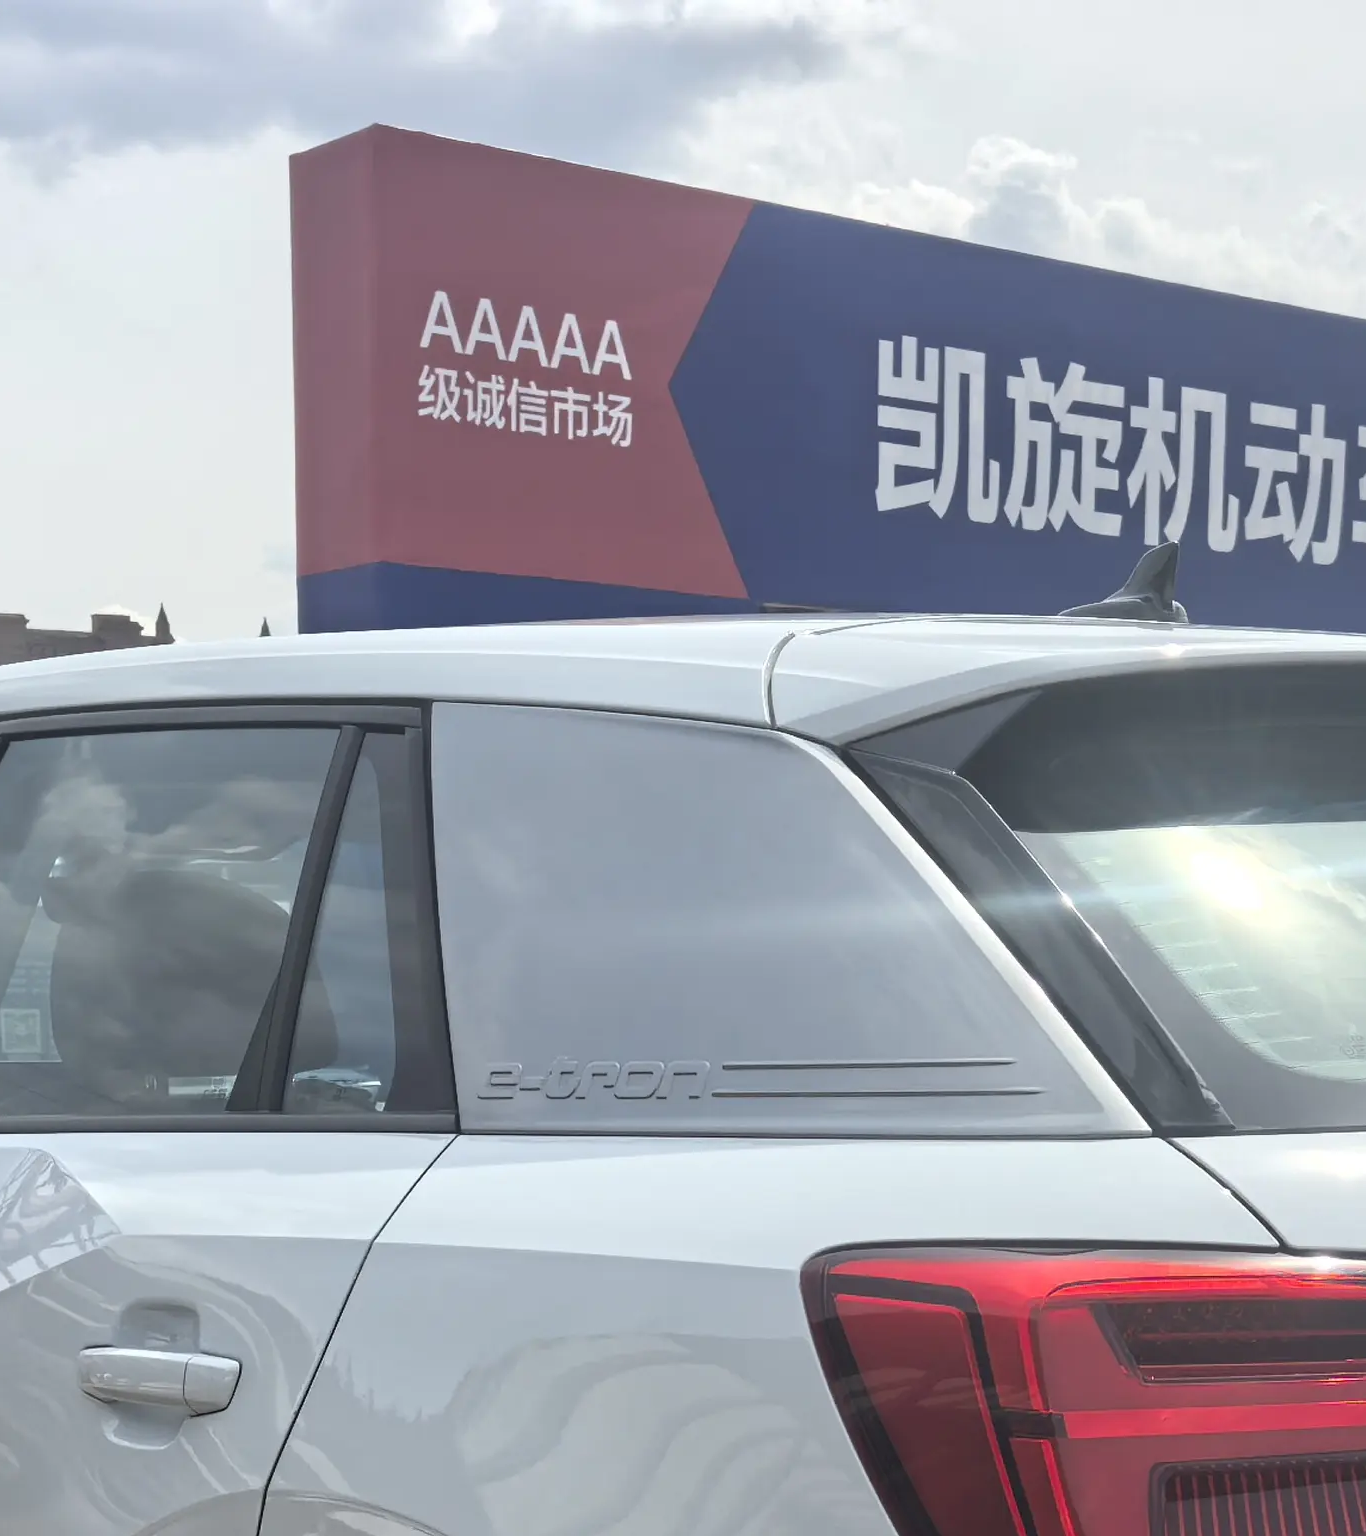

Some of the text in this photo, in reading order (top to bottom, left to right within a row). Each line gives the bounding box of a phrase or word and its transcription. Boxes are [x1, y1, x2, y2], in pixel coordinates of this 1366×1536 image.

[420, 290, 632, 380] AAAAA
[418, 365, 633, 448] 级诚信市场
[476, 1056, 711, 1100] e-tron
